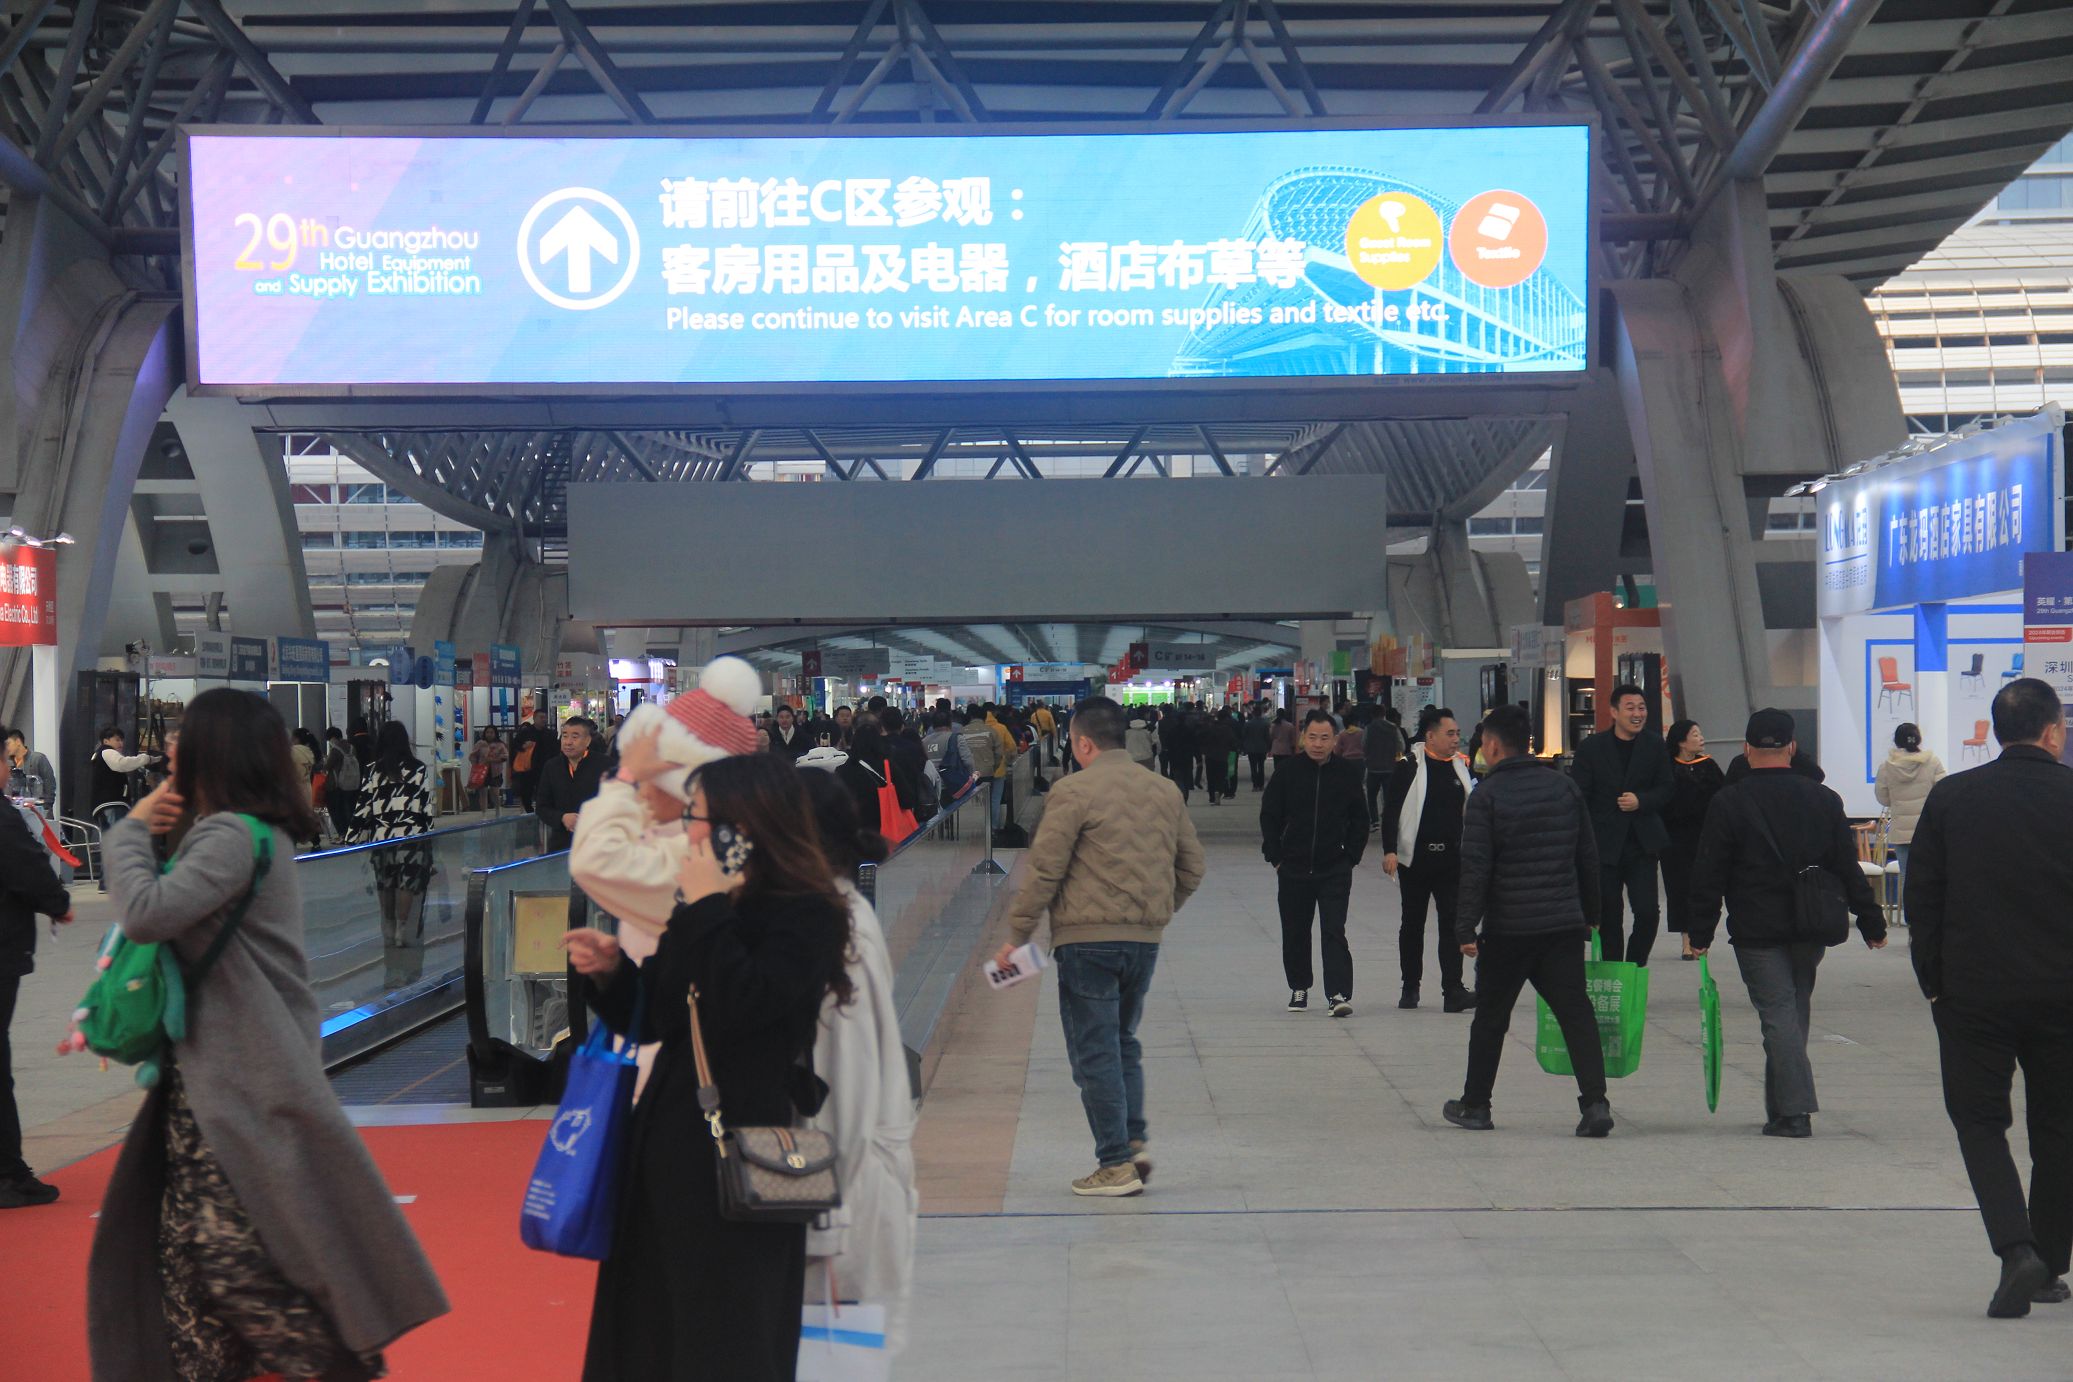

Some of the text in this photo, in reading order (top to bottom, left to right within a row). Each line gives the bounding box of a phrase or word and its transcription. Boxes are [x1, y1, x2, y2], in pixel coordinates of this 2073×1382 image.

[659, 175, 1024, 229] 请前往C区参观：
[234, 211, 480, 270] 29th Guangzhou
[320, 251, 471, 274] Hotel Equipment
[255, 270, 481, 297] and Supply Exhibition
[666, 307, 745, 330] Please
[752, 306, 860, 329] continue
[866, 307, 893, 329] to
[900, 305, 950, 328] visit
[956, 305, 1013, 328] Area
[1020, 304, 1038, 327] C
[1045, 303, 1082, 327] for
[1089, 309, 1154, 327] room
[1162, 301, 1263, 331] supplies
[1269, 300, 1316, 324] and
[1323, 299, 1400, 323] textile
